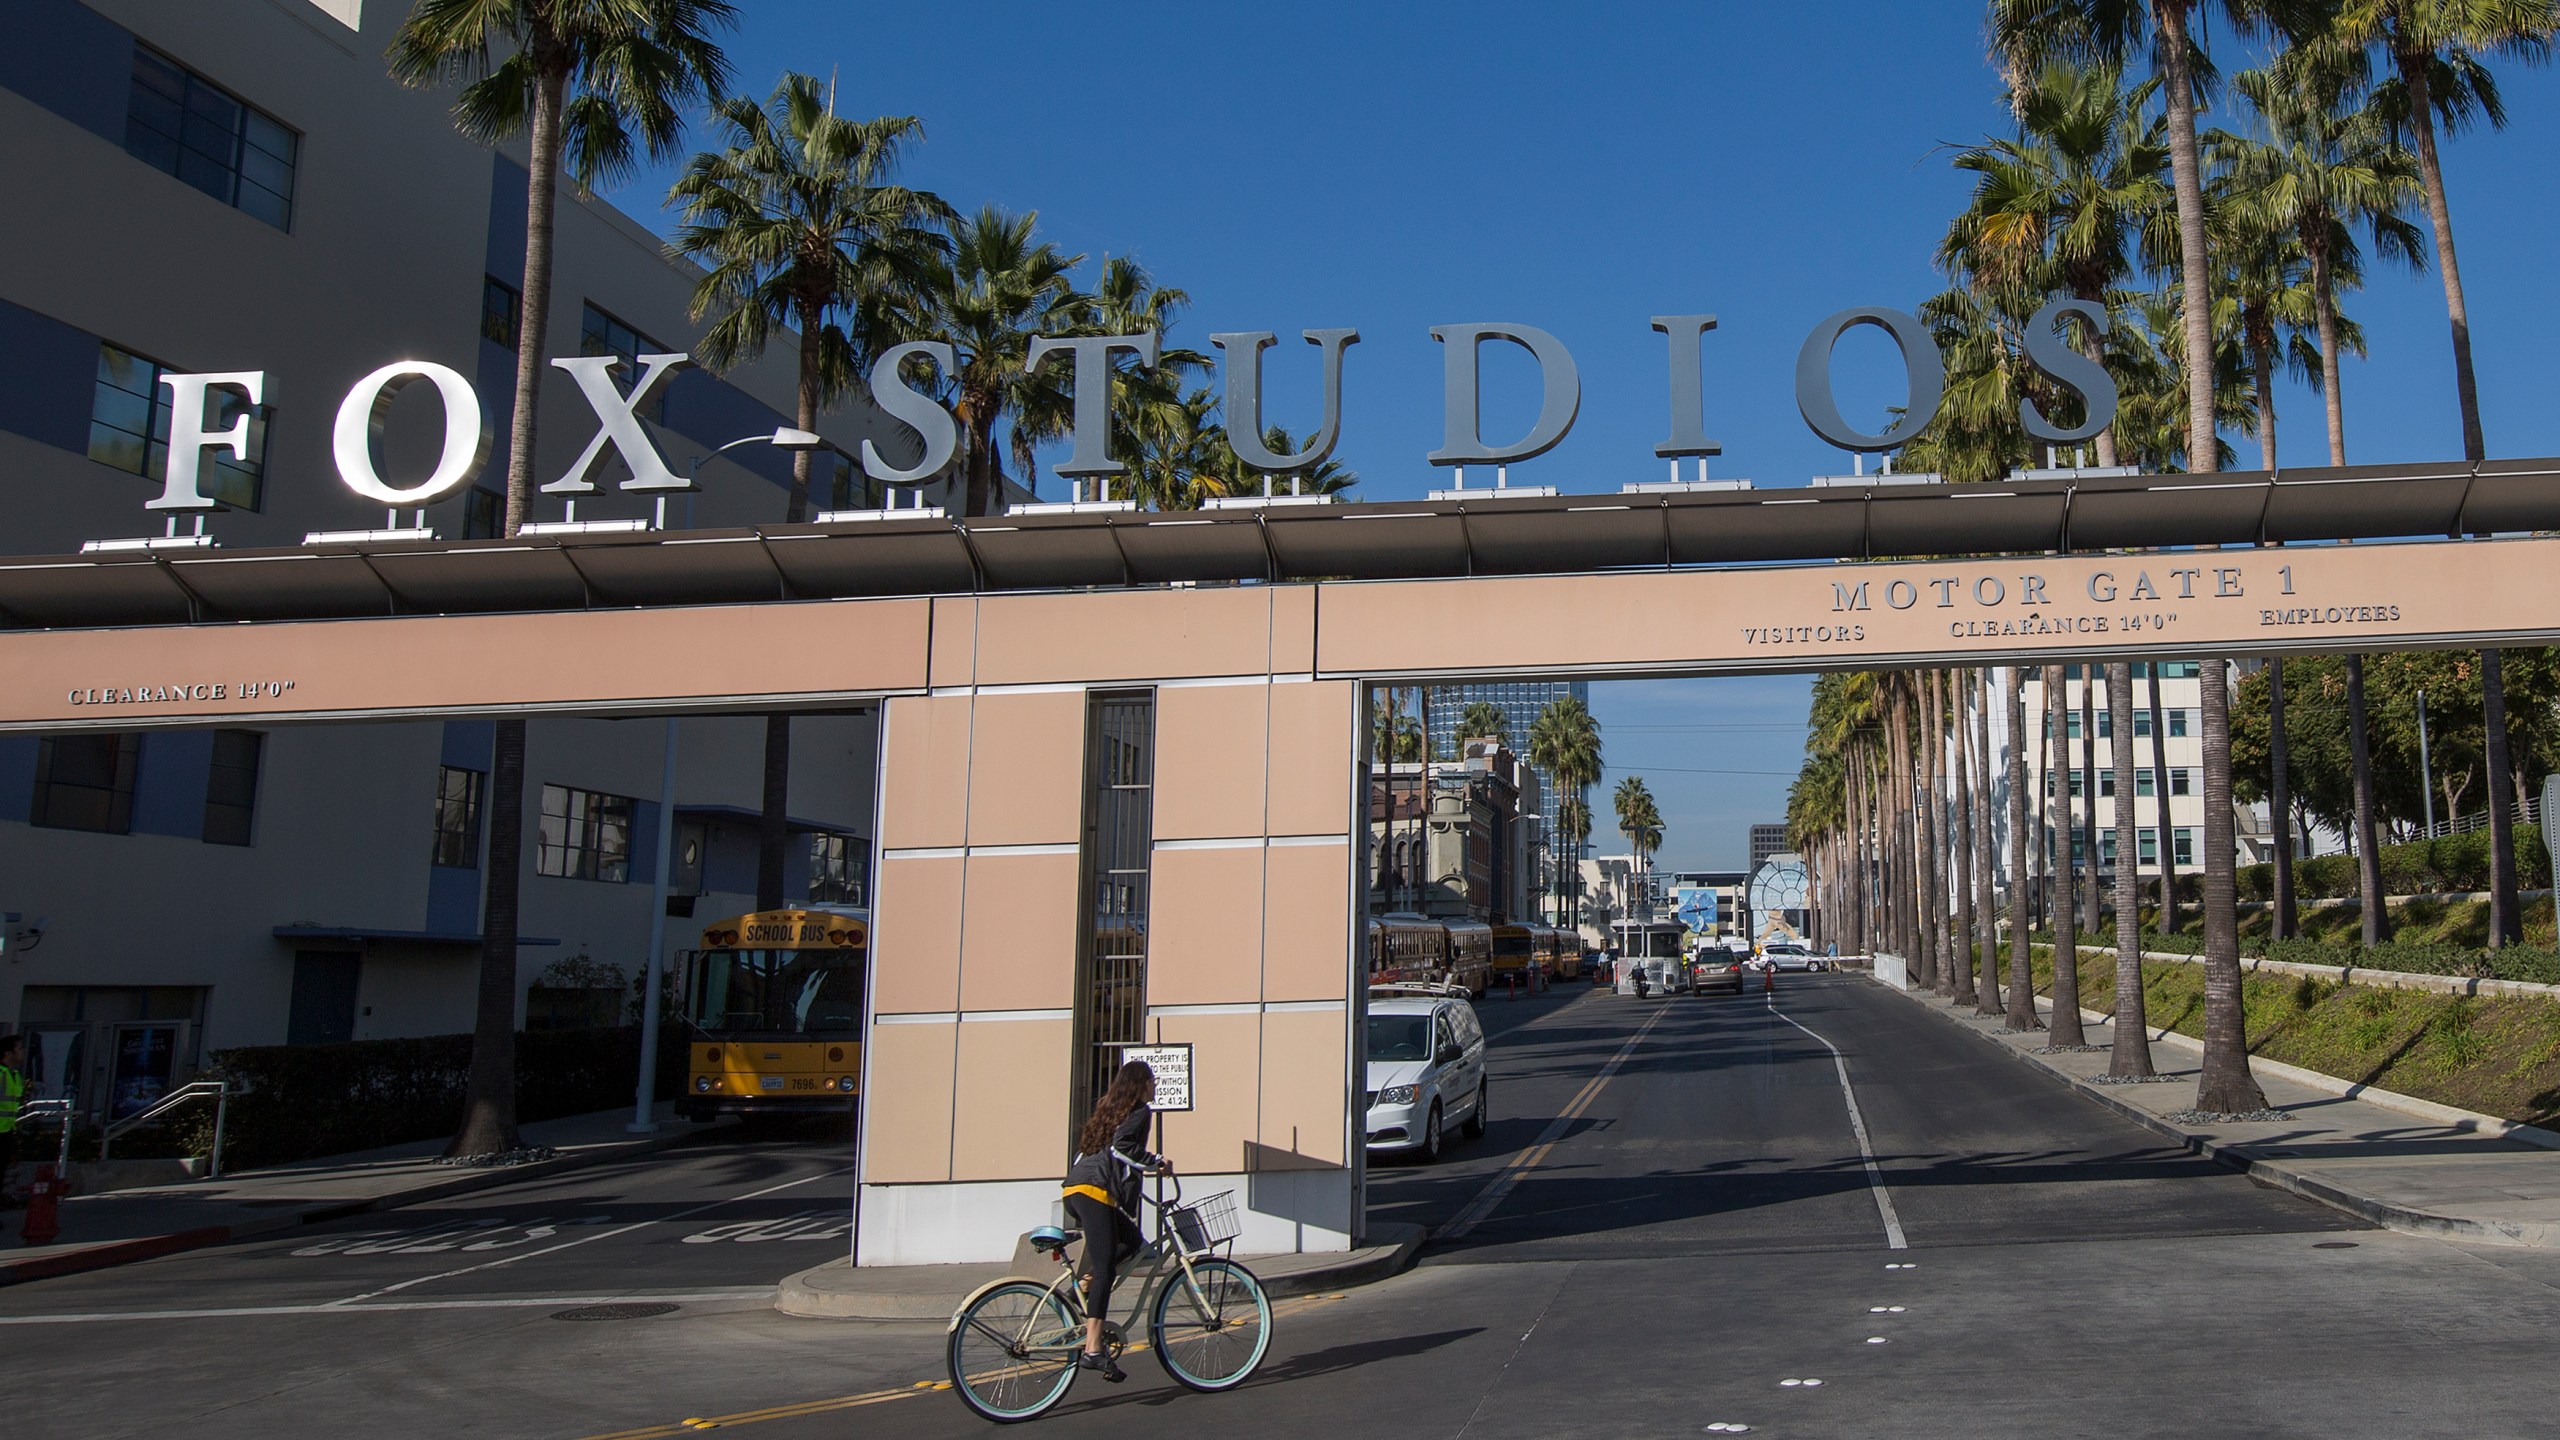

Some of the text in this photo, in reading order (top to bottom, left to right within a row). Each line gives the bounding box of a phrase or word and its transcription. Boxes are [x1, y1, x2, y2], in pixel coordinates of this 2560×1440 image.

[145, 299, 2118, 514] FOX STUDIOS
[1831, 563, 2297, 612] MOTOR GATE 1
[2260, 604, 2401, 627] EMPLOYEES
[1741, 624, 1866, 645] VISITORS
[1949, 615, 2110, 638] CLEARANCE
[67, 683, 227, 705] CLEARANCE
[746, 925, 825, 943] SCHOOL BUS
[1146, 1054, 1179, 1063] PROPERTY
[1181, 1053, 1188, 1062] IS
[1159, 1064, 1169, 1073] THE
[791, 1078, 814, 1090] 7696
[1161, 1077, 1188, 1086] WITHOU
[1156, 1087, 1181, 1096] ISSION
[1168, 1096, 1187, 1106] 41.24
[681, 1208, 852, 1244] TOP
